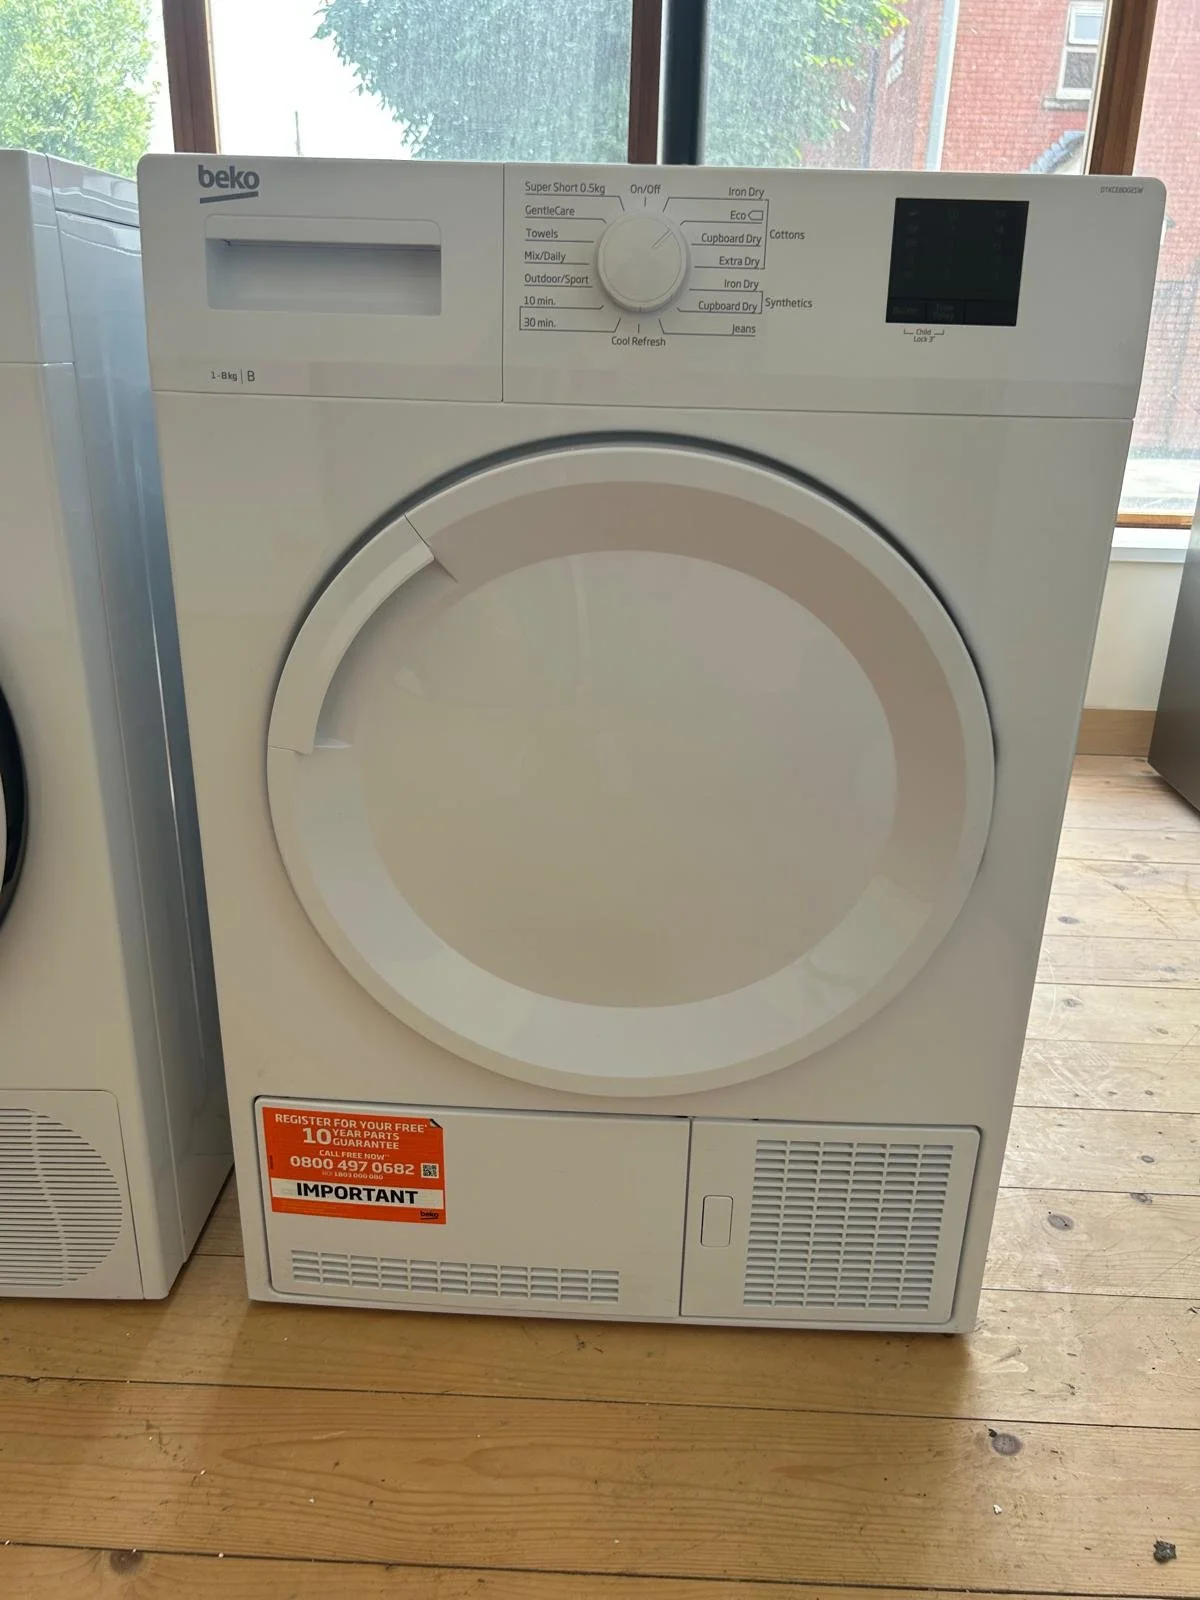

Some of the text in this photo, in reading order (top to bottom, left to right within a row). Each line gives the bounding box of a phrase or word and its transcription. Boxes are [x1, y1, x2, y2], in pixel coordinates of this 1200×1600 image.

[198, 164, 260, 190] beko
[525, 182, 606, 195] Super Short 0.5kg
[630, 184, 661, 195] On/Off
[728, 187, 765, 199] Iron Dry
[525, 205, 575, 217] GentleCare
[730, 211, 747, 221] Eco
[526, 228, 559, 239] Towels
[701, 233, 762, 246] Cupboard Dry
[769, 230, 806, 240] Cottons
[524, 251, 566, 263] Mix/Daily
[719, 256, 760, 268] Extra Dry
[524, 273, 589, 286] Outdoor/Sport
[724, 279, 760, 291] Iron Dry
[524, 296, 557, 306] 10 min.
[765, 297, 813, 309] Synthetics
[698, 301, 758, 314] Cupboard Dry
[523, 317, 557, 328] 30 min.
[731, 323, 756, 334] Jeans
[915, 328, 932, 336] Child
[611, 336, 666, 347] Cool Refresh
[247, 370, 256, 382] B
[275, 1113, 332, 1127] REGISTER
[334, 1118, 357, 1129] FOR
[359, 1121, 393, 1131] YOUR
[302, 1127, 332, 1146] 10
[332, 1128, 400, 1141] YEAR PARTS
[332, 1137, 400, 1150] GUARANTEE
[319, 1149, 341, 1158] CALL
[341, 1150, 364, 1159] FREE
[290, 1155, 334, 1170] 0800
[337, 1159, 369, 1173] 497
[371, 1162, 415, 1176] 0682
[296, 1182, 419, 1204] IMPORTANT
